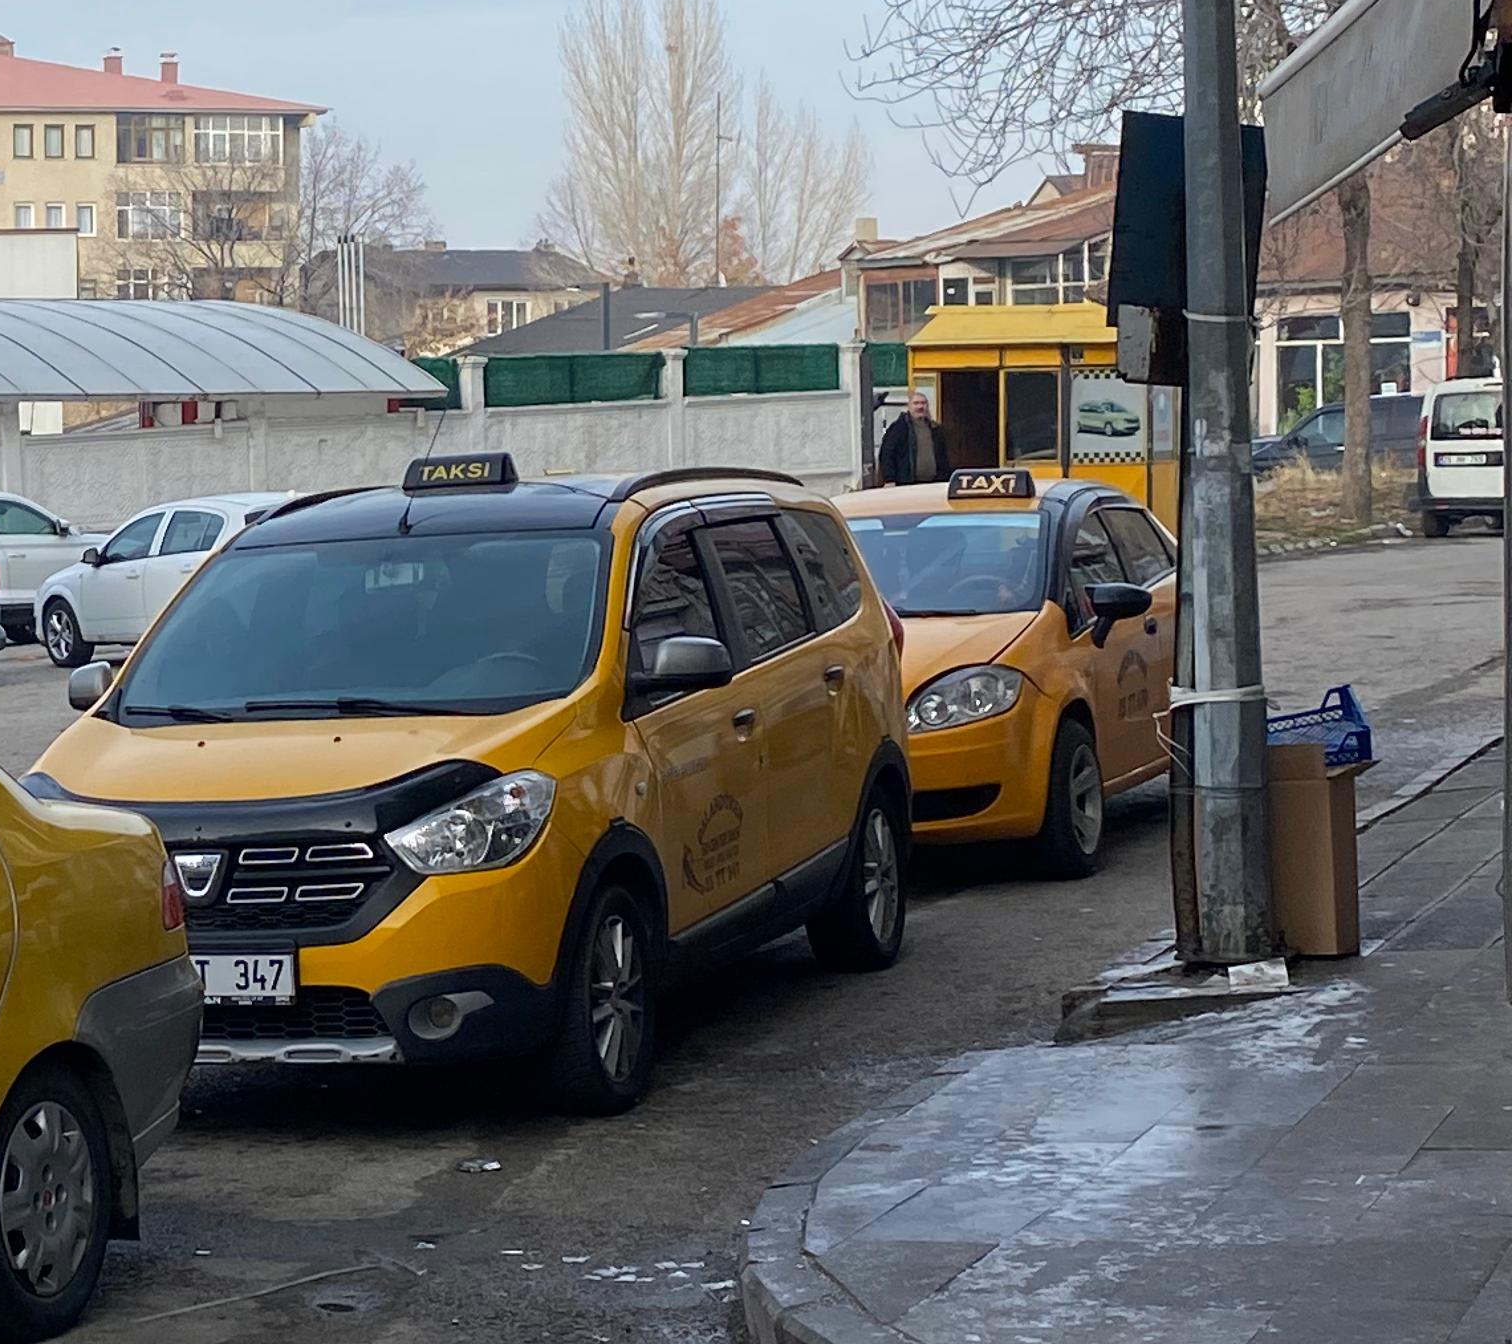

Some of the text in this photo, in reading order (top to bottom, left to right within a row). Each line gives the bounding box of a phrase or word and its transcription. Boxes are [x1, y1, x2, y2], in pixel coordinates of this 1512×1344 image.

[419, 462, 491, 482] TAKSI
[956, 474, 1017, 494] TAXI
[234, 959, 284, 991] 347
